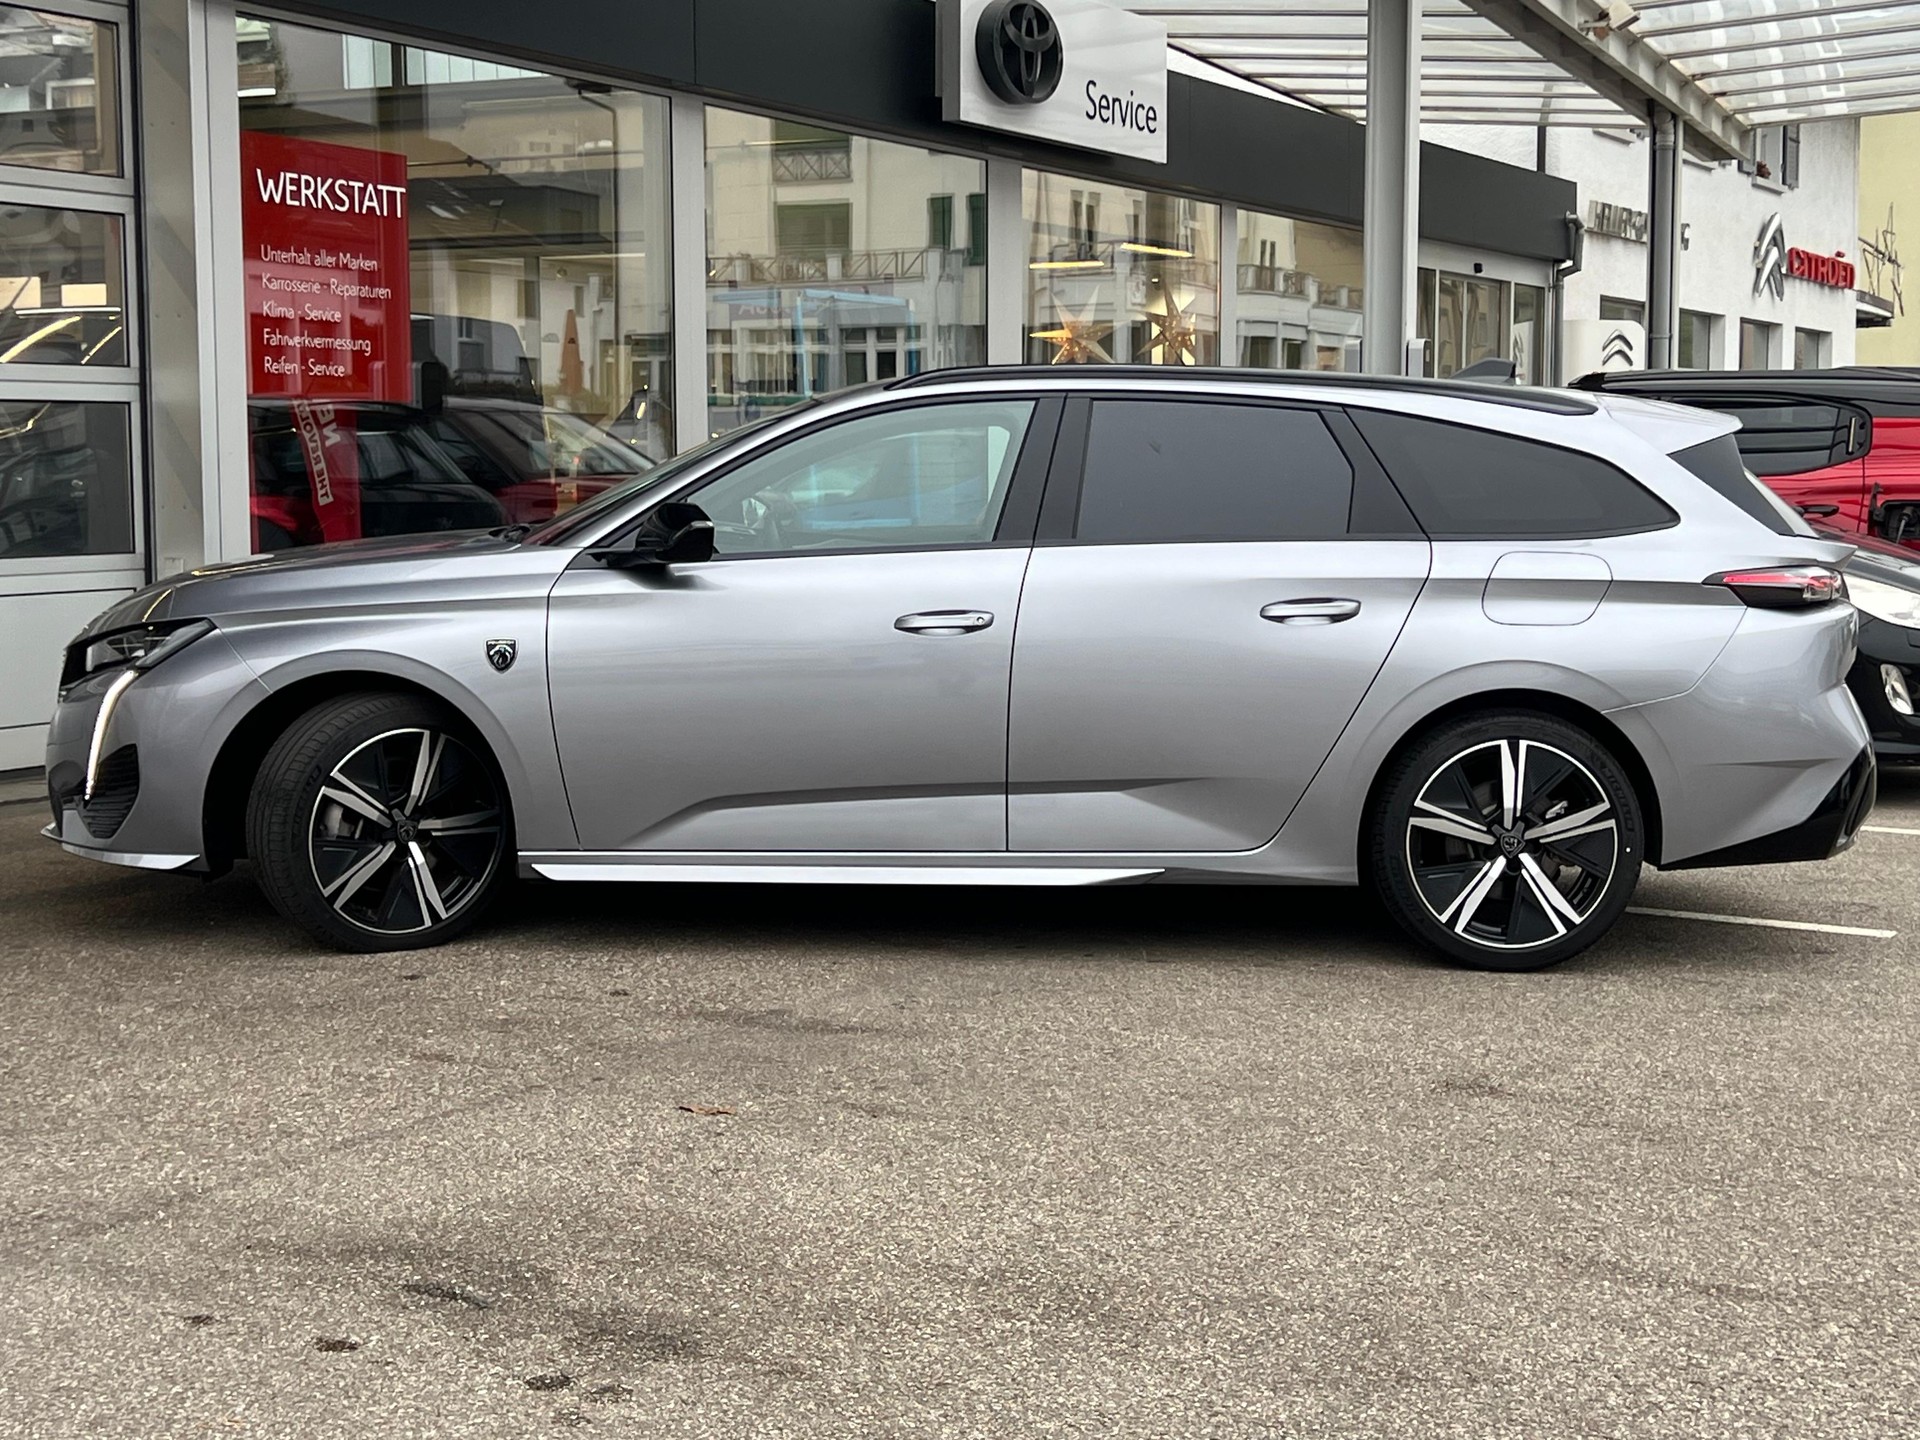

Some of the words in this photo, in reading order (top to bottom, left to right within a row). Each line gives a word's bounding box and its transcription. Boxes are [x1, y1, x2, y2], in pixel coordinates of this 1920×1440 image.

[1085, 79, 1157, 134] Service
[255, 168, 406, 218] WERKSTATT
[260, 245, 311, 266] Unterhalt
[314, 249, 336, 267] aller
[339, 253, 378, 272] Marken
[262, 273, 321, 294] Karrosserie
[330, 278, 392, 300] Reparaturen
[262, 301, 295, 319] Klima
[304, 304, 342, 323] Service
[263, 328, 371, 356] Fahrwerkvermessung
[264, 356, 299, 375] Reifen
[308, 358, 346, 377] Service
